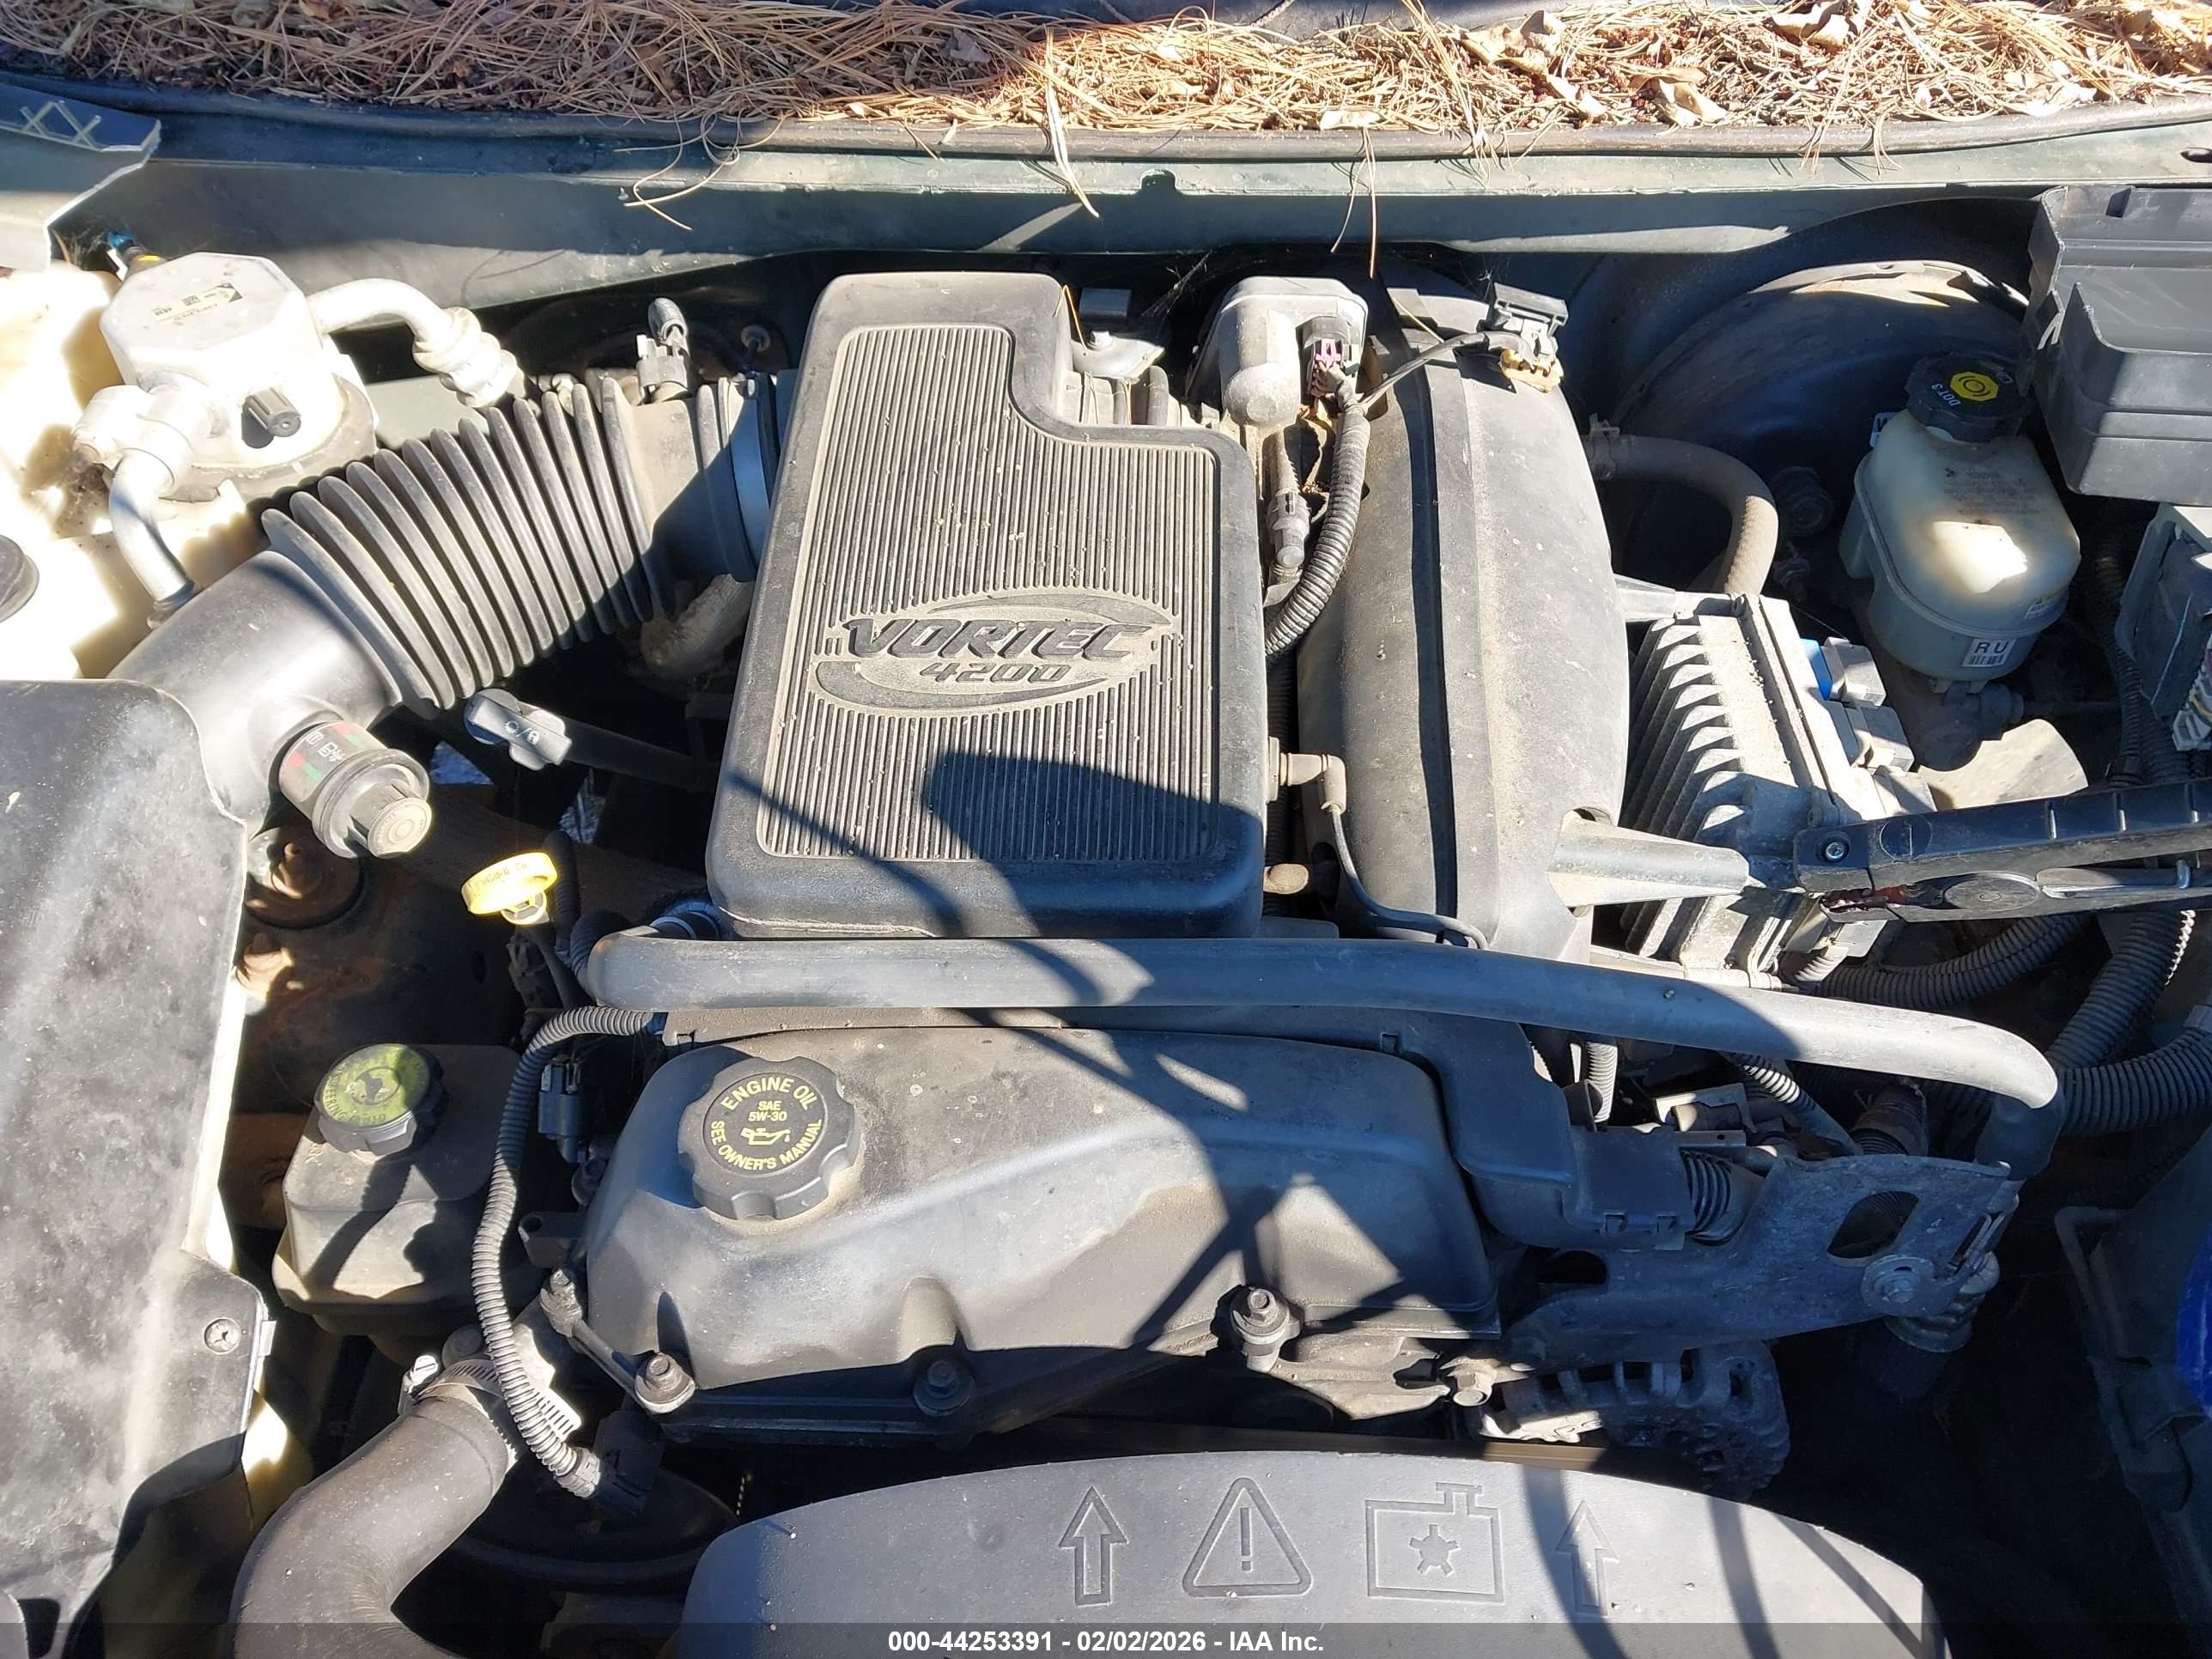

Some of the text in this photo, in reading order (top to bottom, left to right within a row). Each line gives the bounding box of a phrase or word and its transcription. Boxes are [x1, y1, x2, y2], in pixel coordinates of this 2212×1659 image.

[1937, 391, 1961, 406] DOT
[842, 618, 1153, 659] VORTEC
[920, 662, 1072, 684] 4200
[720, 1077, 817, 1110] ENGINE OIL
[748, 1111, 787, 1121] 5W-30
[757, 1100, 781, 1111] SAE
[711, 1119, 822, 1171] SEE OWNER'S MANUAL
